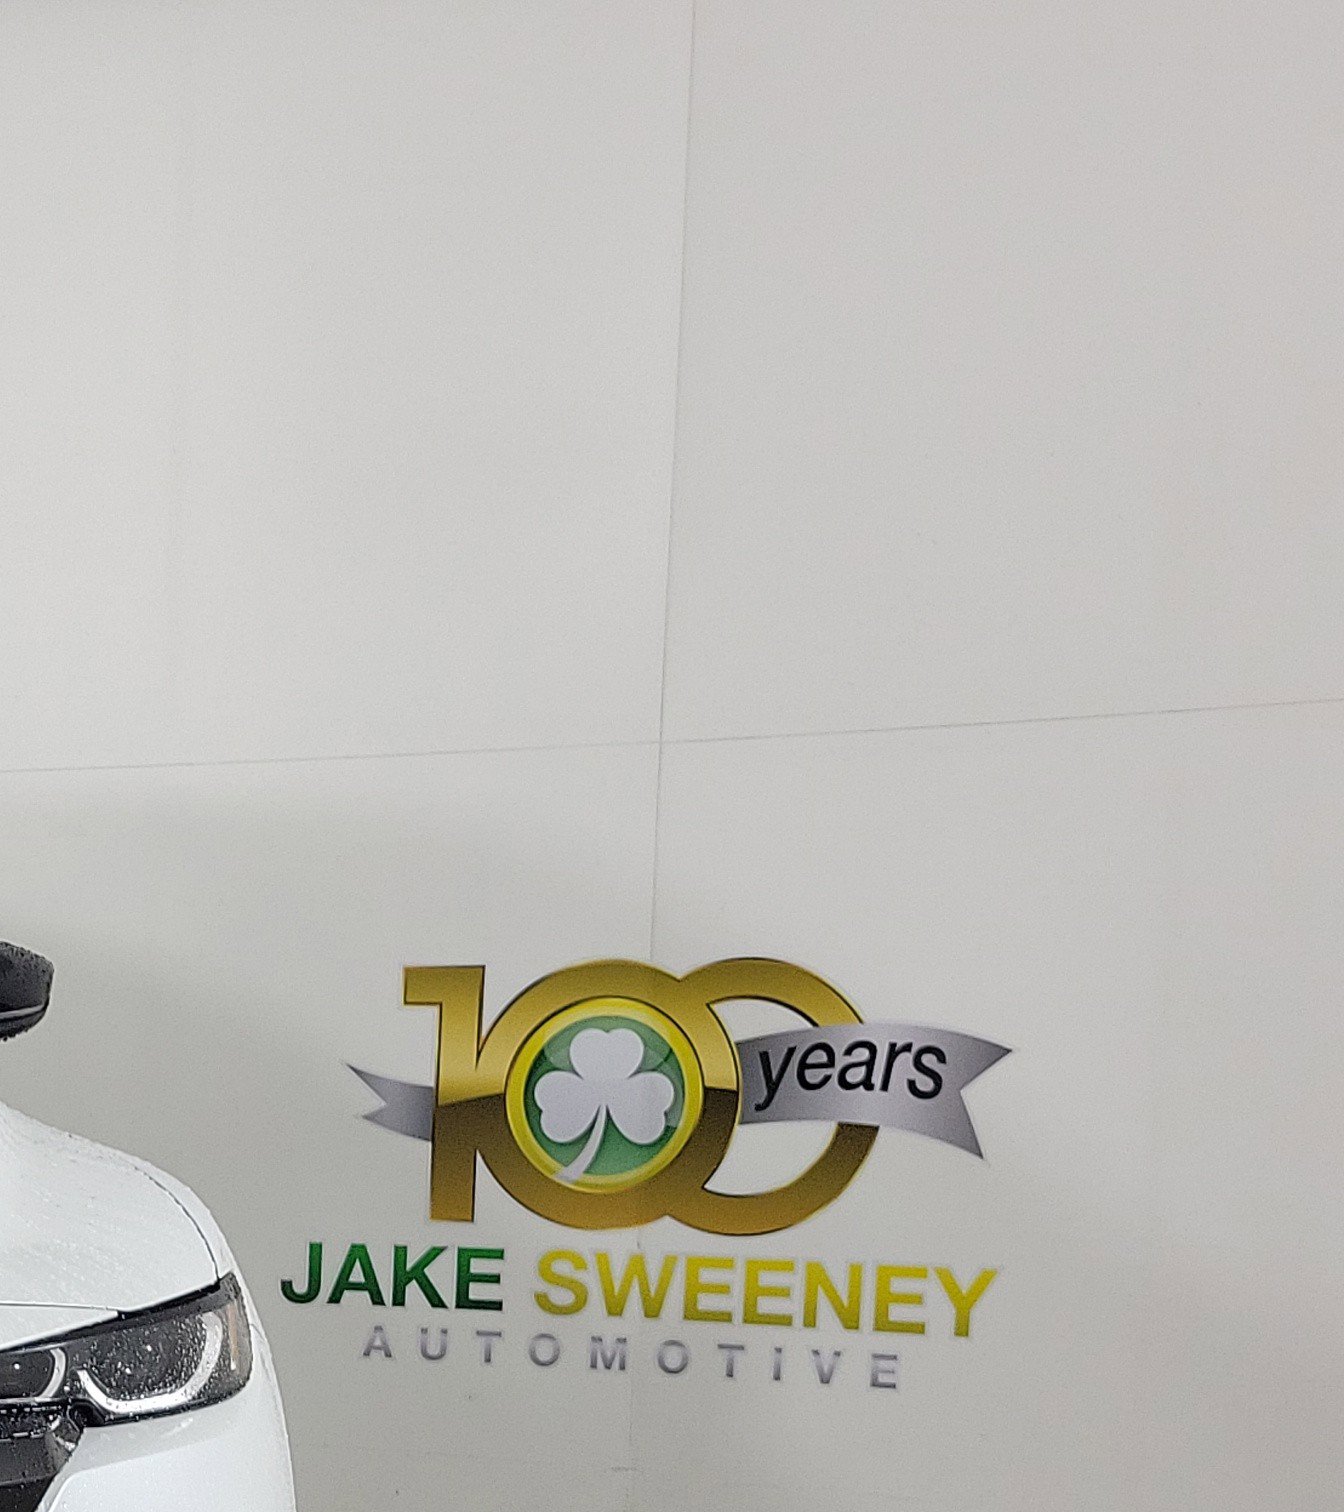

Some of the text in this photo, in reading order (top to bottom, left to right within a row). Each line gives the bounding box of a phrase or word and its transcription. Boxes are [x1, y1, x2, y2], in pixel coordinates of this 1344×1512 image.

[403, 957, 947, 1236] 100 years
[280, 1242, 998, 1338] JAKE SWEENEY
[362, 1325, 899, 1390] AUTOMOTIVE
